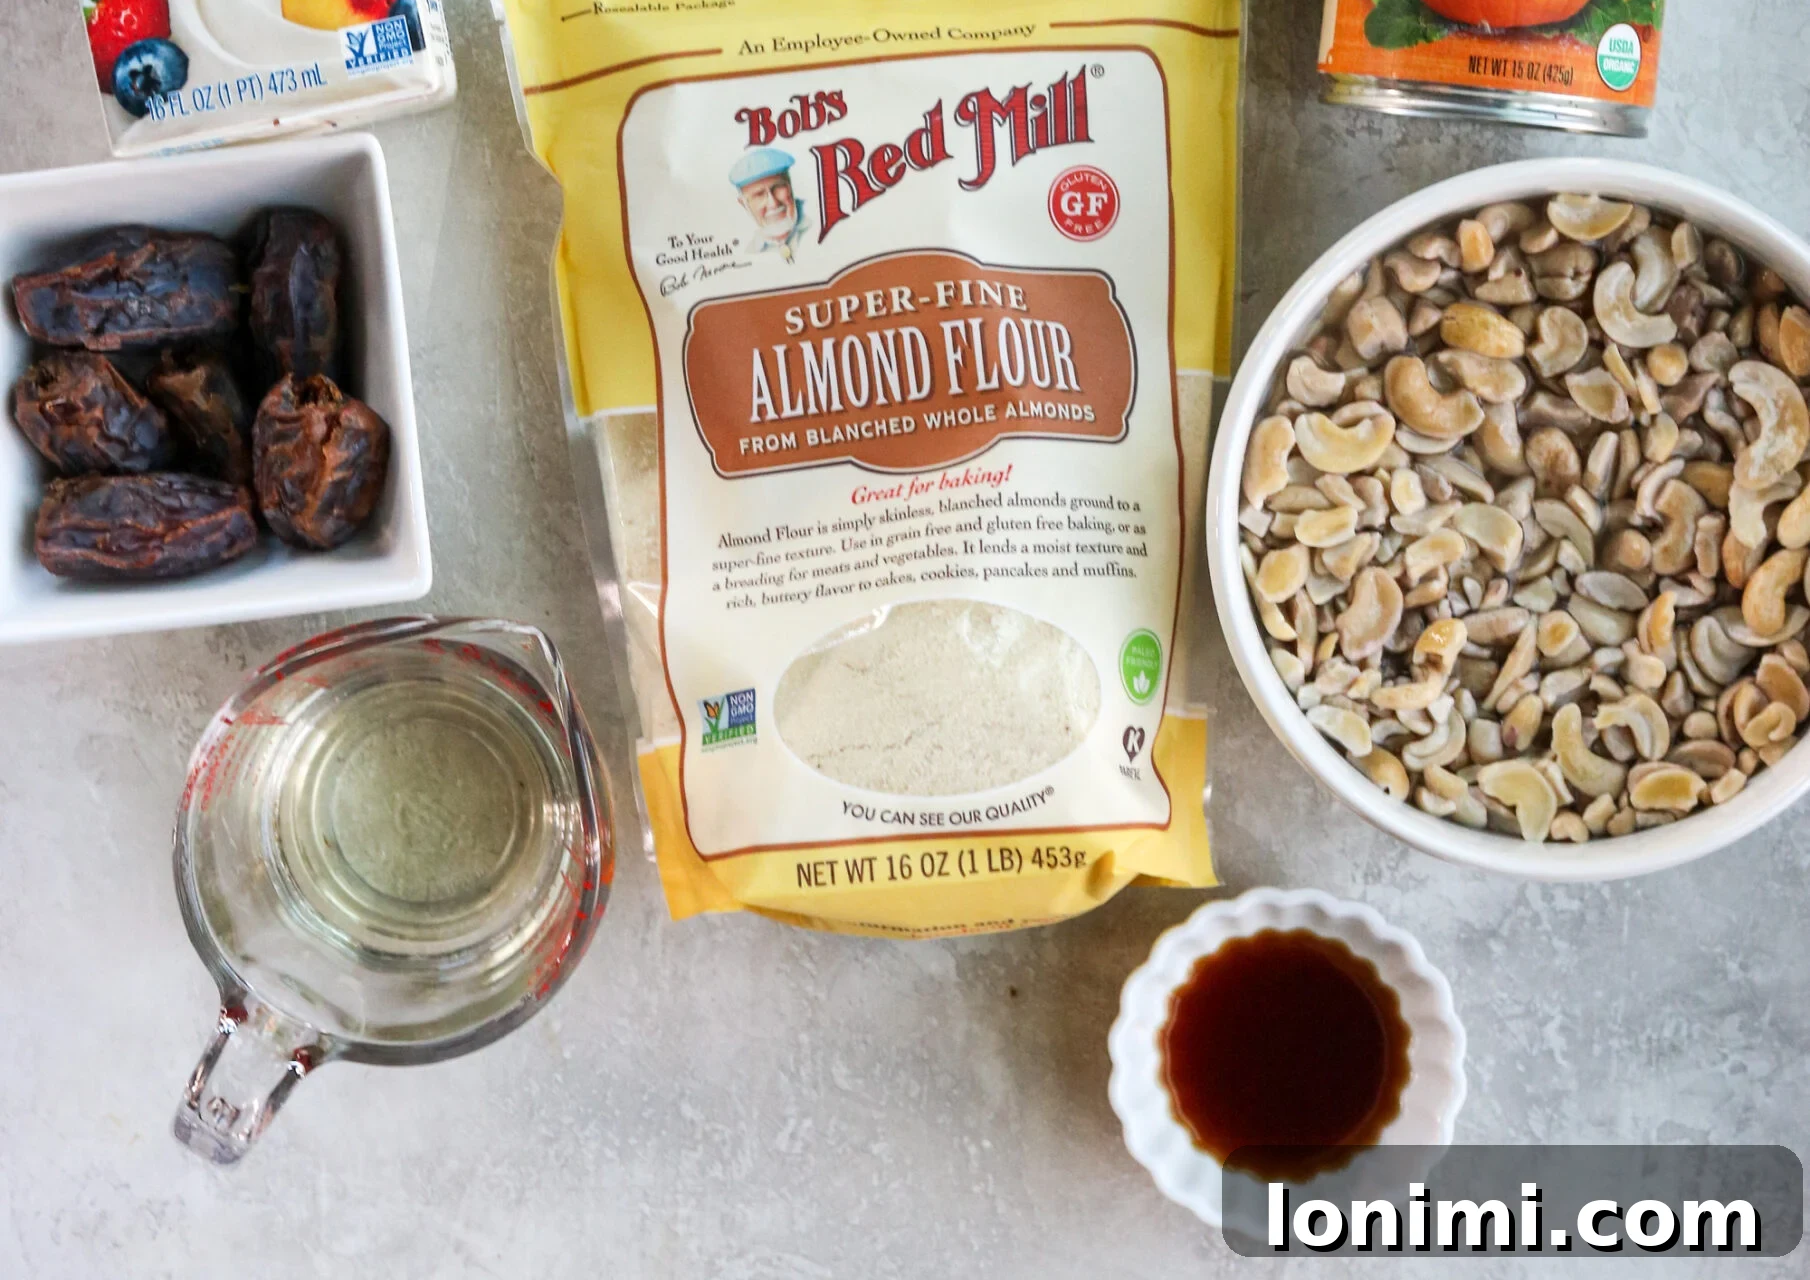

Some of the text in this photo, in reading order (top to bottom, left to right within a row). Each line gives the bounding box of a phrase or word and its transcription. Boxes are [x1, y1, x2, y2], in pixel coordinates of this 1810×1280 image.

[738, 23, 1037, 56] An Employee-Owned Company
[1609, 37, 1634, 55] USDA
[1468, 55, 1574, 87] NET WT 15 OZ (425g)
[146, 93, 166, 122] 16
[167, 89, 190, 118] FL
[192, 84, 216, 113] OZ
[218, 80, 232, 109] (1
[236, 72, 264, 103] PT)
[268, 68, 298, 97] 473
[300, 63, 328, 90] mL
[734, 88, 849, 149] Bob's
[809, 63, 1095, 246] Red Mill
[1060, 171, 1107, 192] GLUTEN
[1060, 190, 1109, 217] GF
[668, 235, 684, 249] To
[1064, 217, 1105, 235] FREE
[655, 243, 733, 266] Good Health
[784, 279, 1029, 336] SUPER-FINE
[750, 316, 1083, 424] ALMOND FLOUR
[739, 400, 1097, 456] FROM BLANCHED WHOLE ALMONDS
[851, 463, 1013, 505] Great for baking!
[718, 491, 1131, 550] Almond Flour simply skinless, blanched almonds ground to
[785, 543, 837, 562] texture.
[841, 537, 868, 553] Use
[870, 535, 884, 548] in
[886, 527, 922, 549] grain
[925, 523, 953, 538] free
[956, 516, 983, 532] and
[987, 515, 1033, 535] gluten
[1036, 514, 1064, 531] free
[1067, 515, 1116, 535] baking,
[1118, 523, 1132, 533] or
[1133, 525, 1147, 536] as
[725, 538, 1150, 592] breading for meats and vegetables. It lends moist texture and
[726, 560, 1138, 611] rich, buttery flavor to cakes, cookies, pancakes and muffins.
[729, 690, 755, 708] NON
[842, 790, 1048, 827] YOU CAN SEE OUR QUALITY
[796, 845, 1088, 888] NET WT 16 OZ (1 LB) 453g
